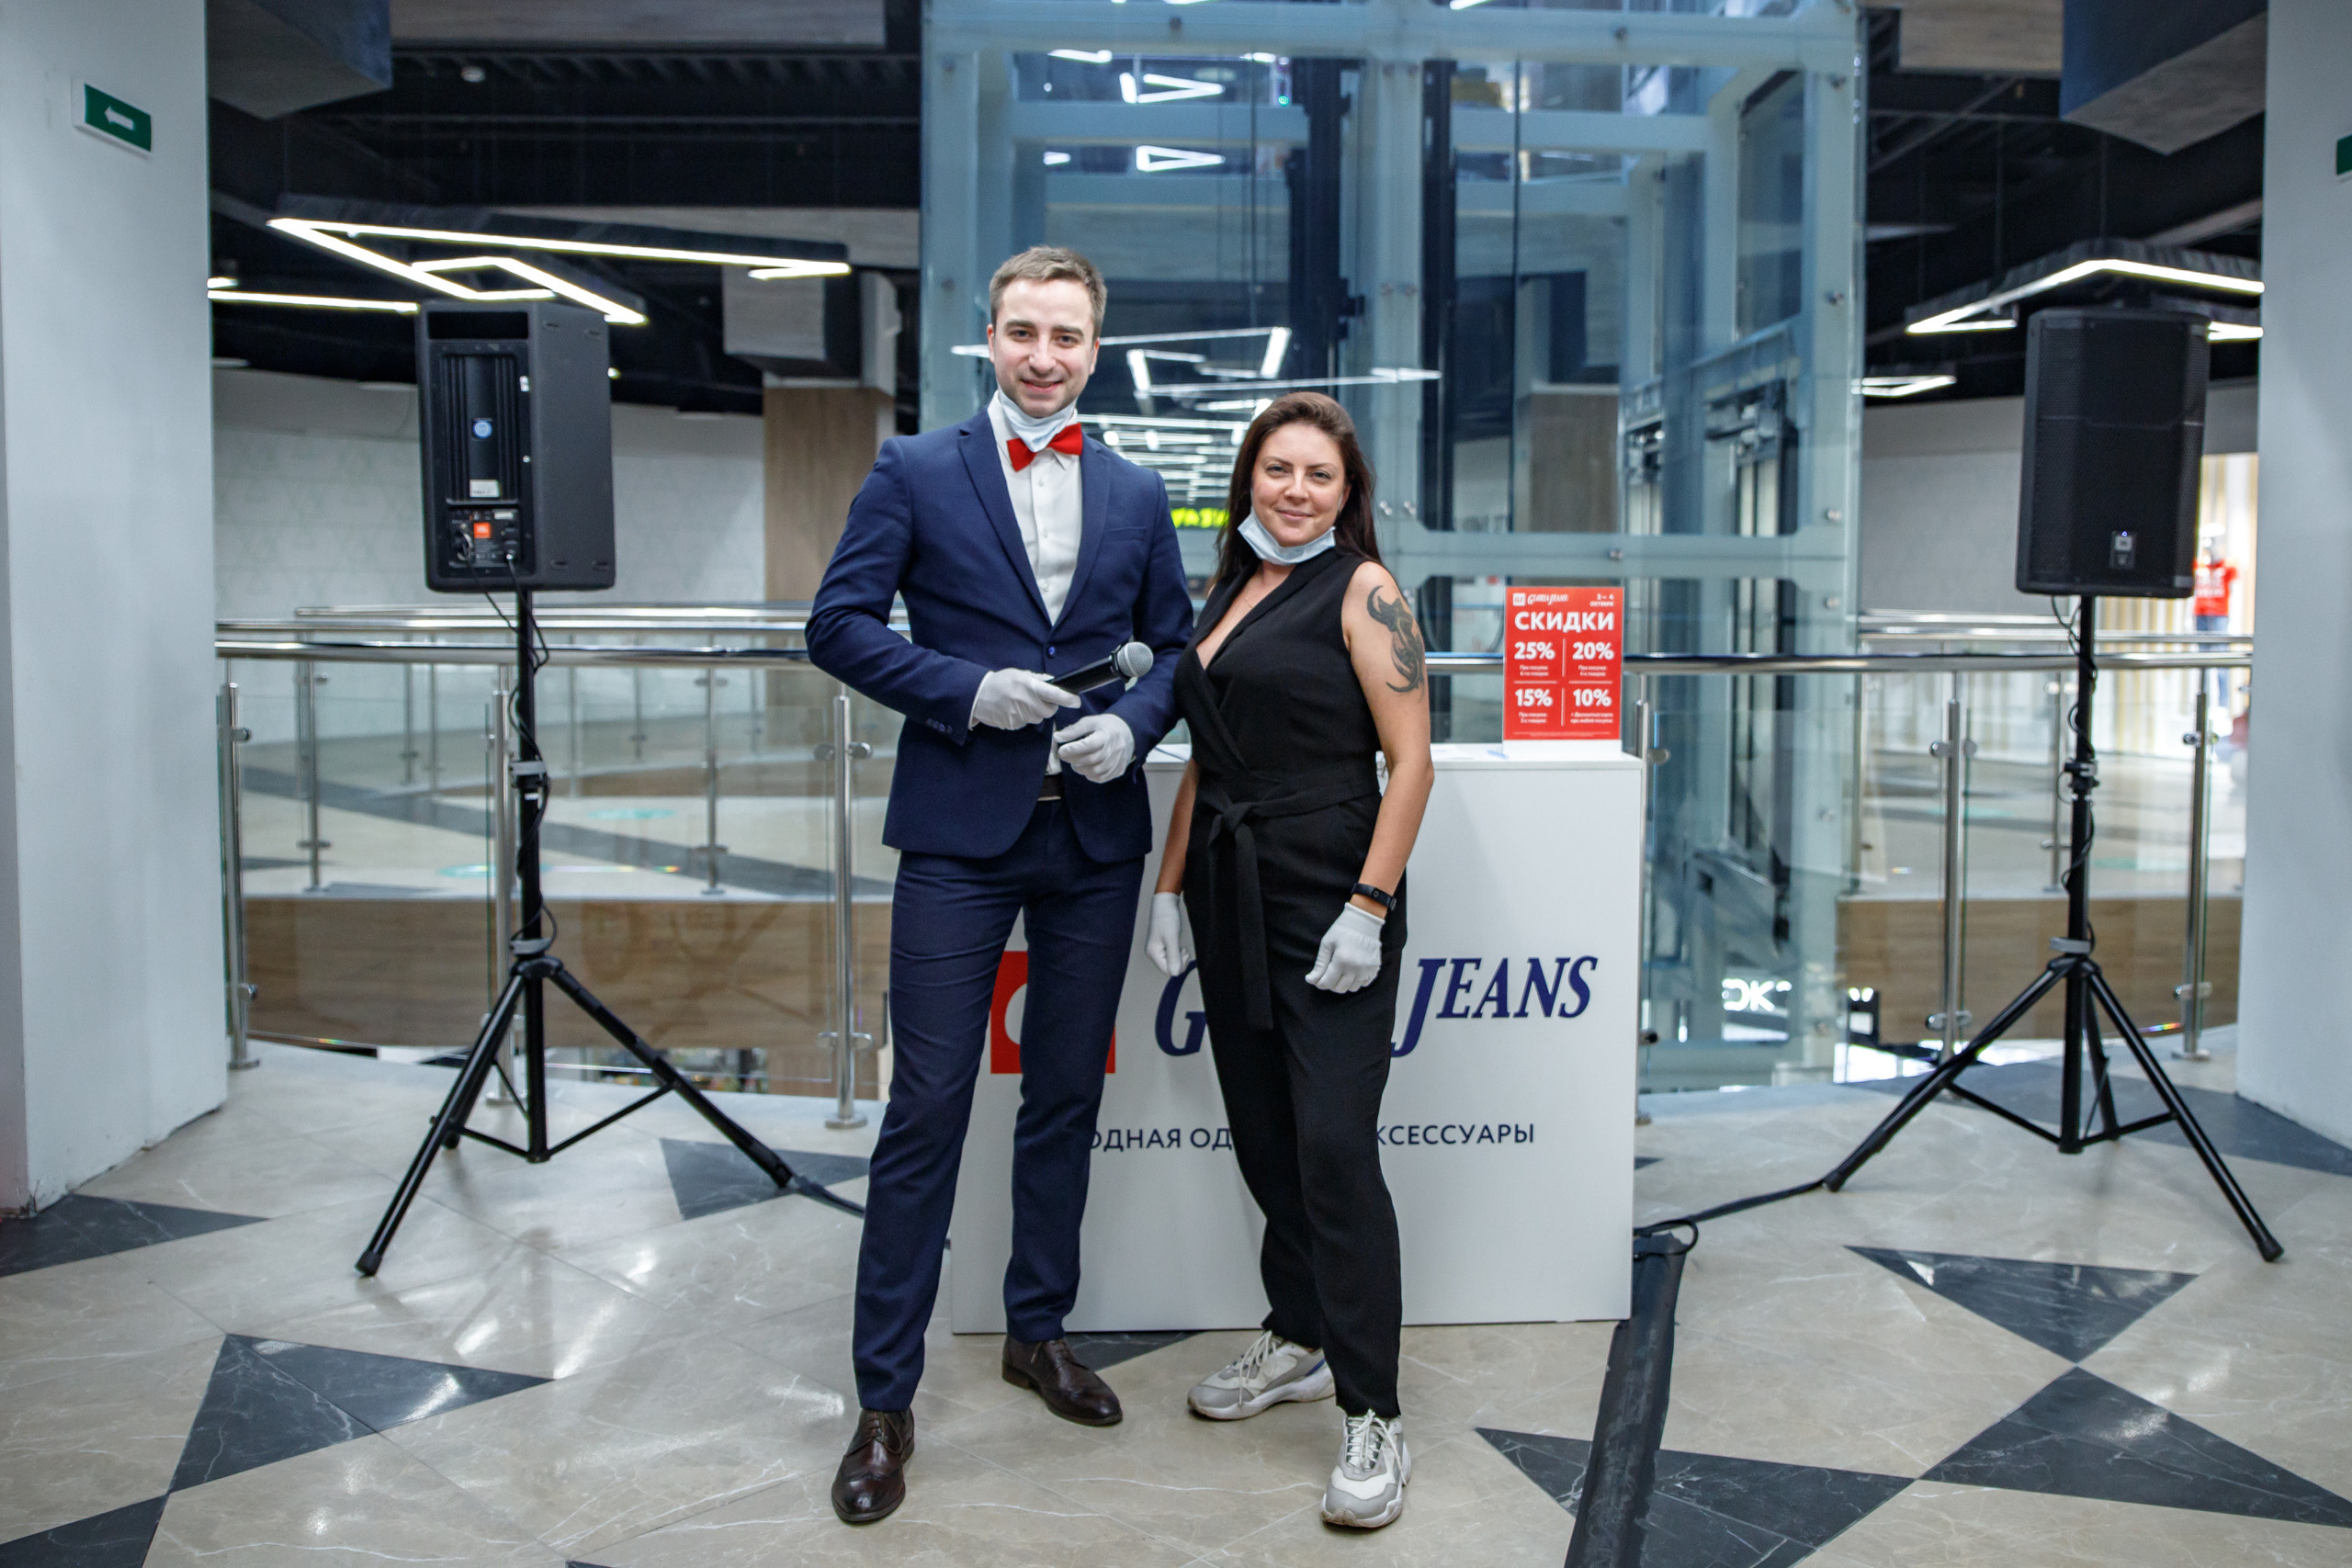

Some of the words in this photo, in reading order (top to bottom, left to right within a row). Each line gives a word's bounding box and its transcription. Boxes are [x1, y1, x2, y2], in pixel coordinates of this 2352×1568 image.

[1514, 612, 1614, 633] СКИДКИ
[1514, 641, 1555, 660] 25%
[1572, 641, 1614, 660] 20%
[1514, 688, 1553, 706] 15%
[1573, 688, 1612, 706] 10%
[1390, 955, 1599, 1057] JEANS
[1091, 1128, 1181, 1152] ОДНАЯ
[1377, 1123, 1534, 1145] КСЕССУАРЫ
